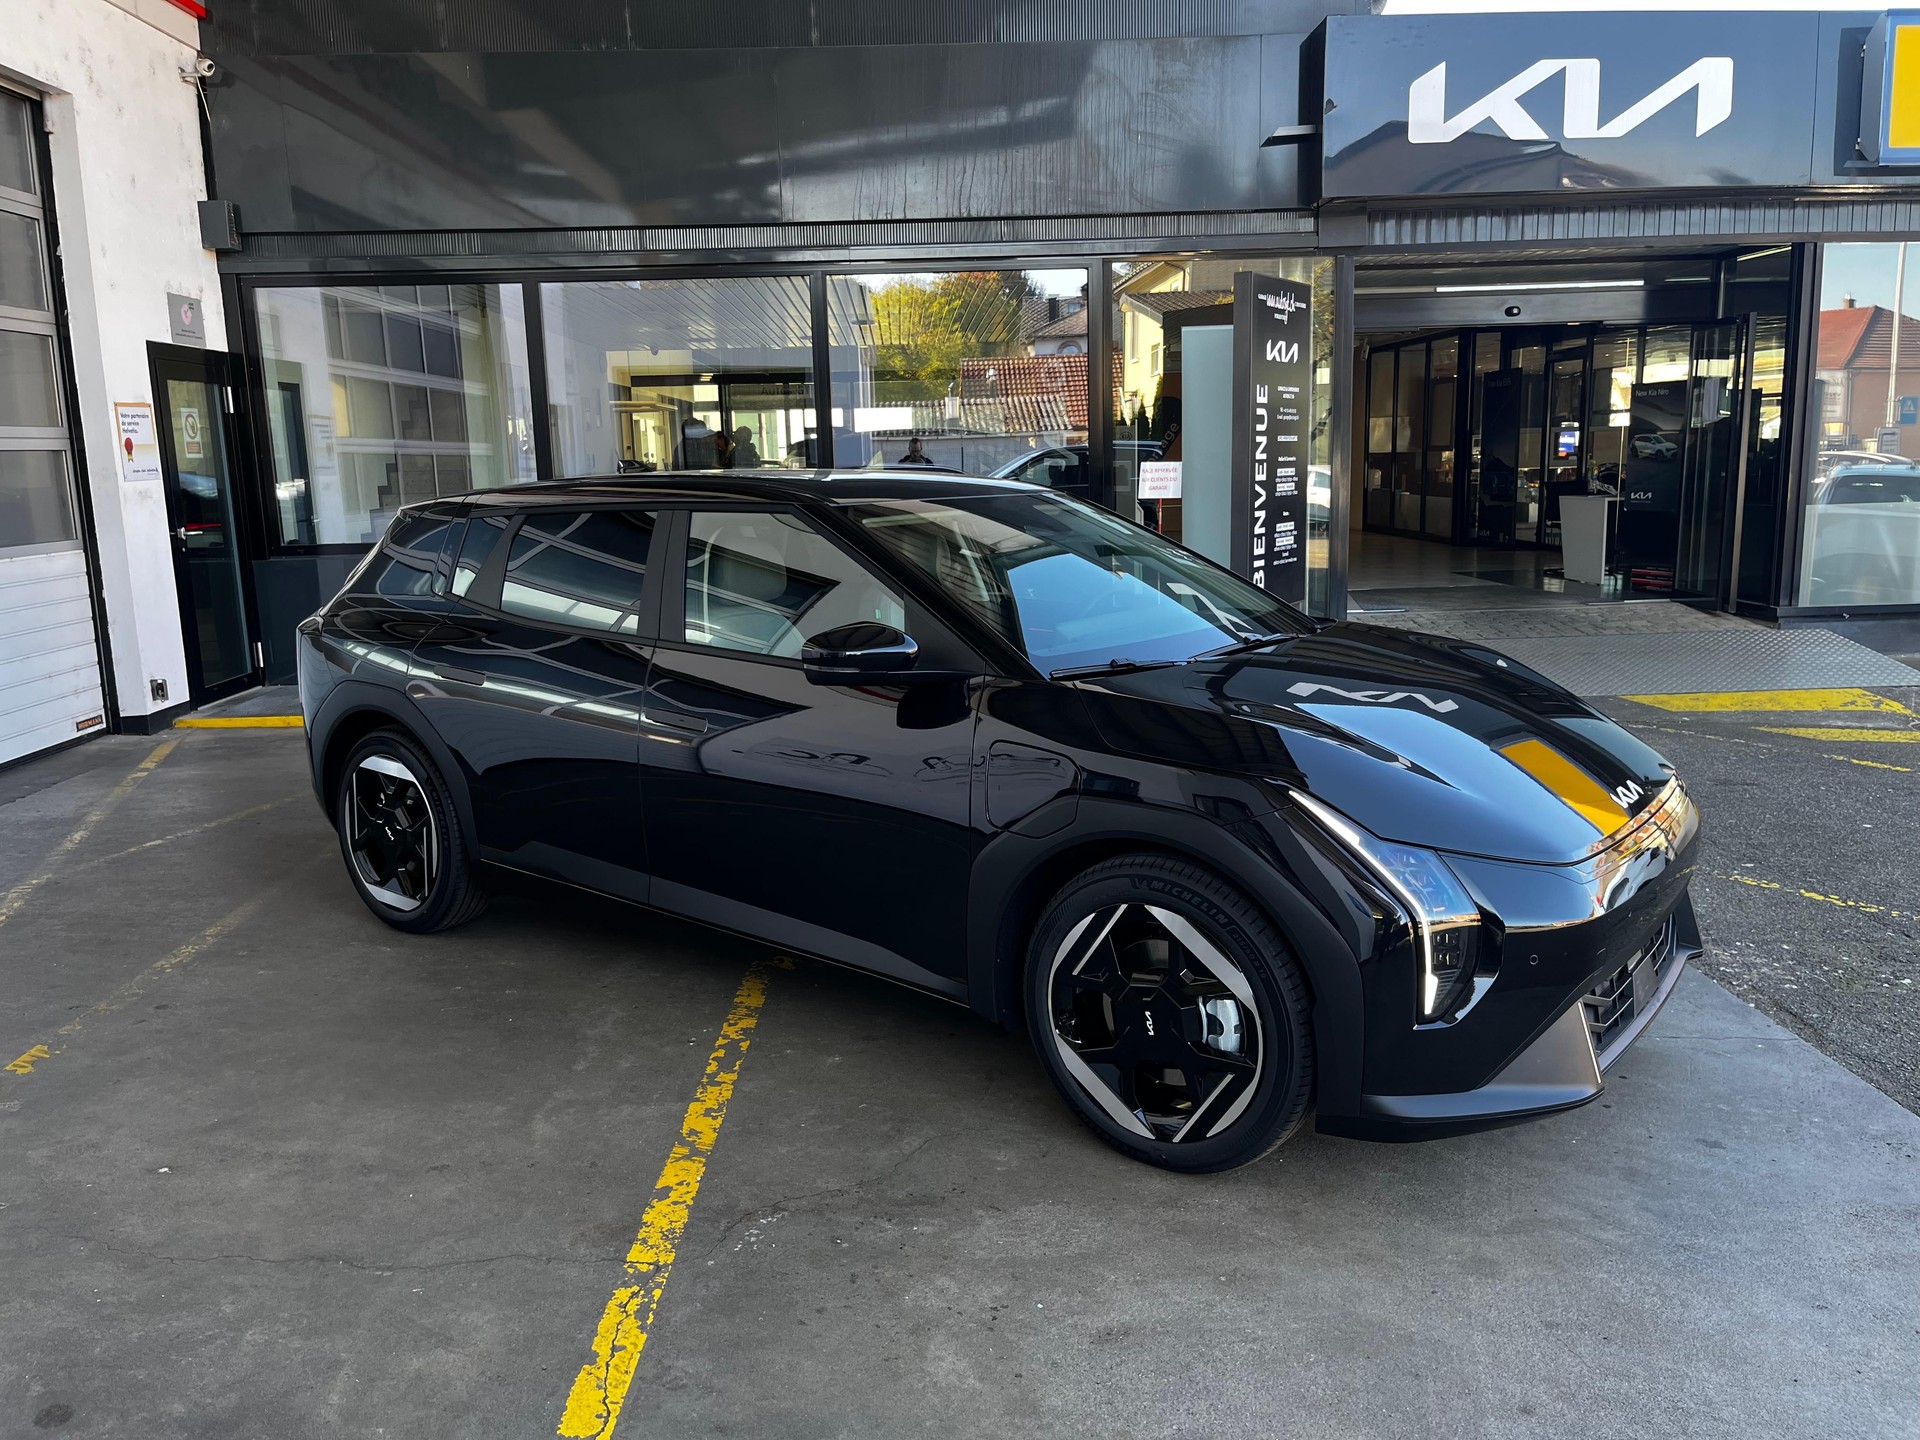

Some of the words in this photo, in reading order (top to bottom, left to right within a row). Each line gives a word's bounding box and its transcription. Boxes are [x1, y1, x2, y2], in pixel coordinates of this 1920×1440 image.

[1408, 57, 1733, 144] KIA
[1266, 339, 1299, 364] KIA
[1253, 384, 1269, 590] BIENVENUE
[1630, 491, 1652, 499] KIA
[1609, 779, 1644, 809] KIA
[1150, 880, 1229, 925] MICHELIN
[1144, 1010, 1155, 1036] KIA
